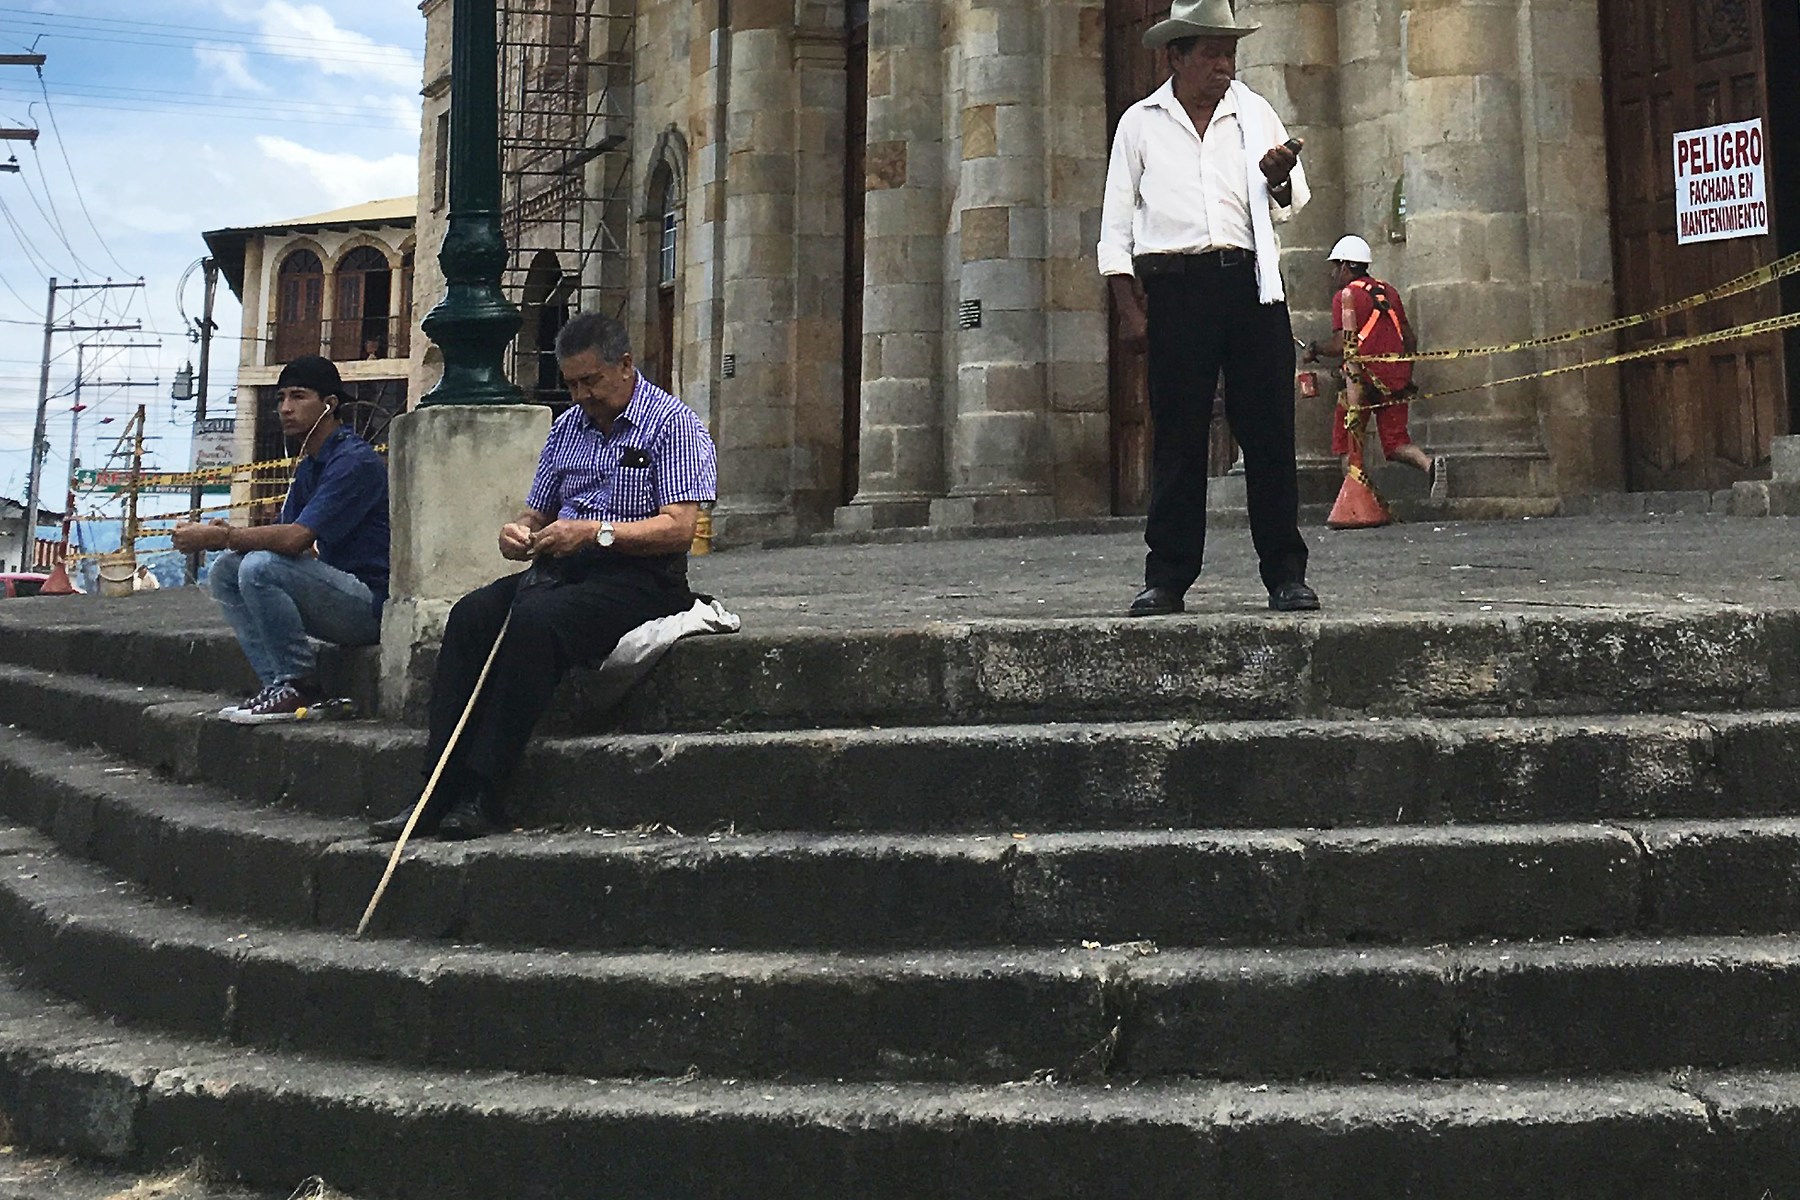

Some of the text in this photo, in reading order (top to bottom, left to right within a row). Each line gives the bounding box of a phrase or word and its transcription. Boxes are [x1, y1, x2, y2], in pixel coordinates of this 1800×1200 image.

[1678, 127, 1762, 177] PELIGRO
[1690, 172, 1753, 206] FACHADA EN
[1680, 201, 1766, 237] MANTENIMIENTO
